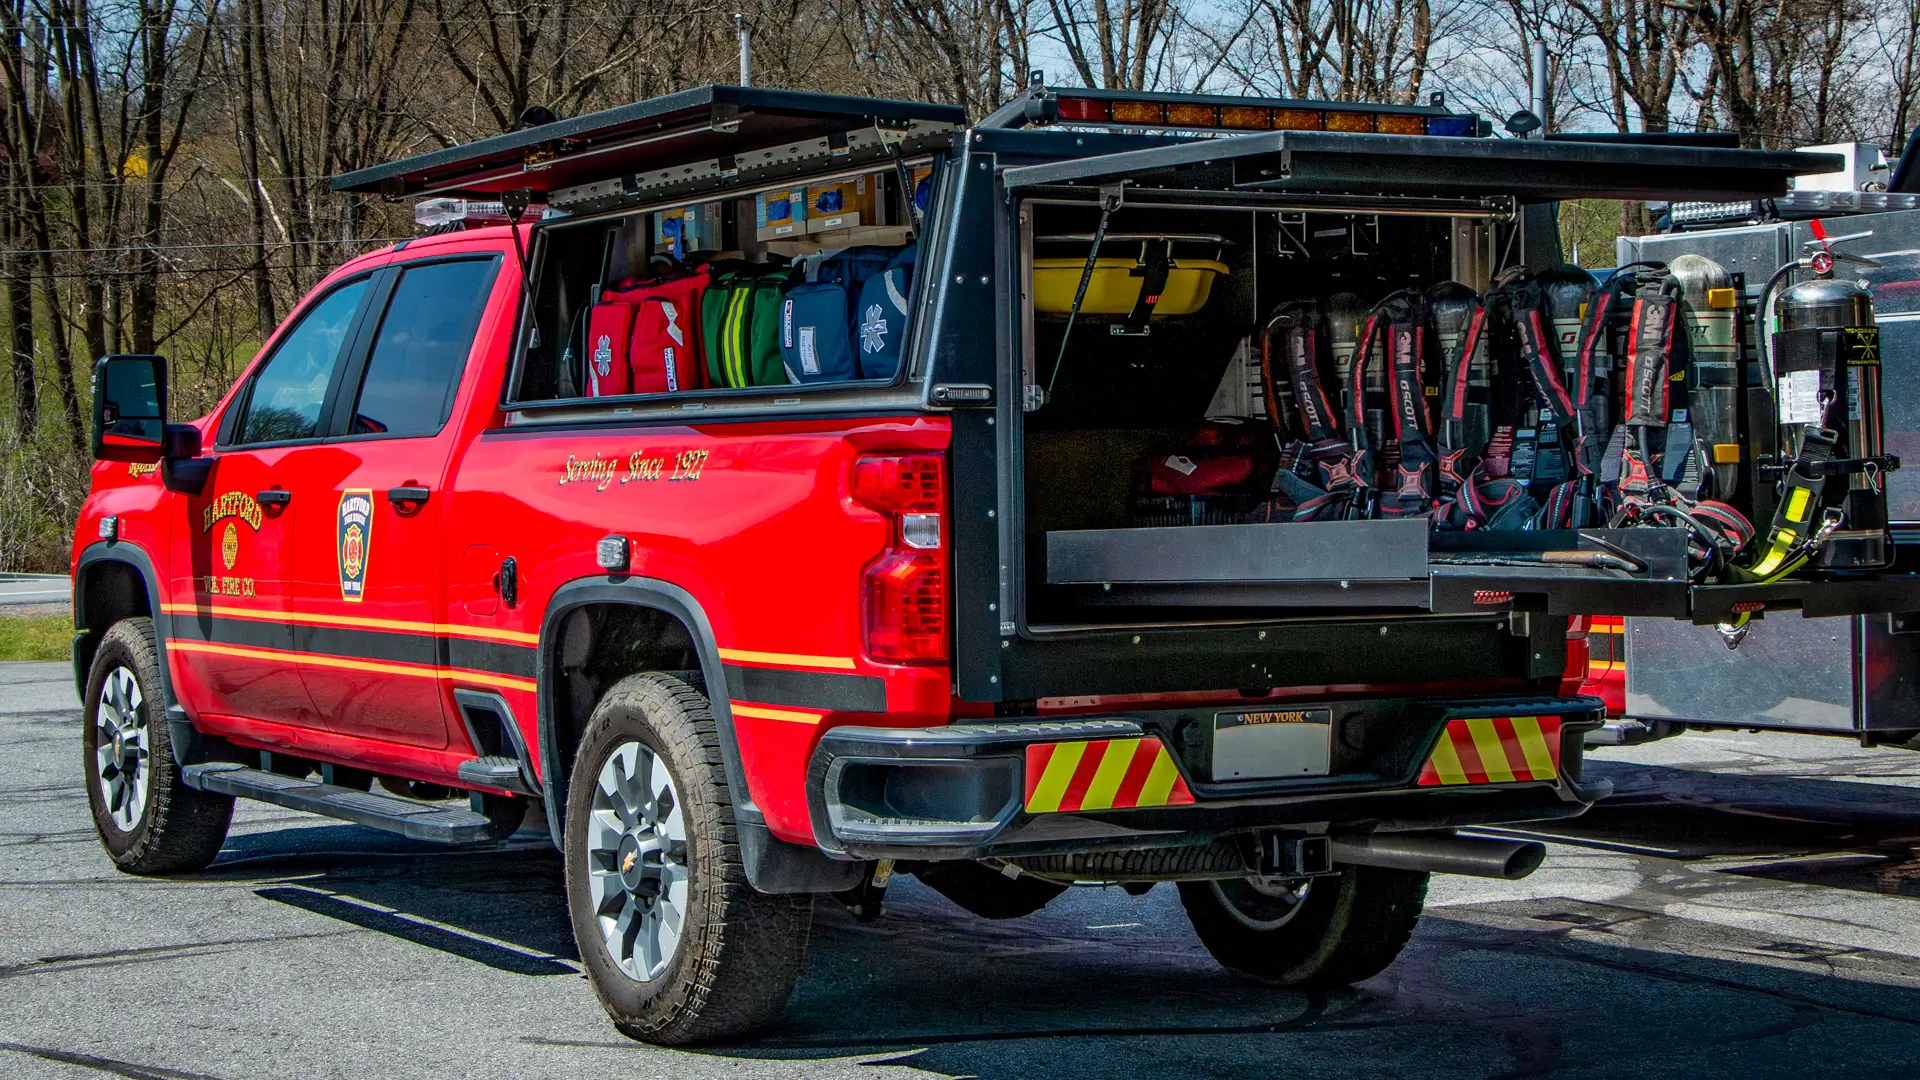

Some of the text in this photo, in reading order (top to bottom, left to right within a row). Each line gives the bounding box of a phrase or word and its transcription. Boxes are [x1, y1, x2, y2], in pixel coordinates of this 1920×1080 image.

[1643, 304, 1666, 339] 3M
[1396, 331, 1412, 364] 3M
[1640, 367, 1653, 413] SCOTT
[1303, 392, 1322, 428] SCOTT
[1402, 391, 1419, 430] SCOTT
[557, 449, 709, 492] Serving Since 1927
[203, 491, 262, 533] HARTFORD
[342, 497, 370, 516] HARTFORD
[222, 576, 240, 595] FIRE
[1244, 711, 1305, 725] NEW YORK
